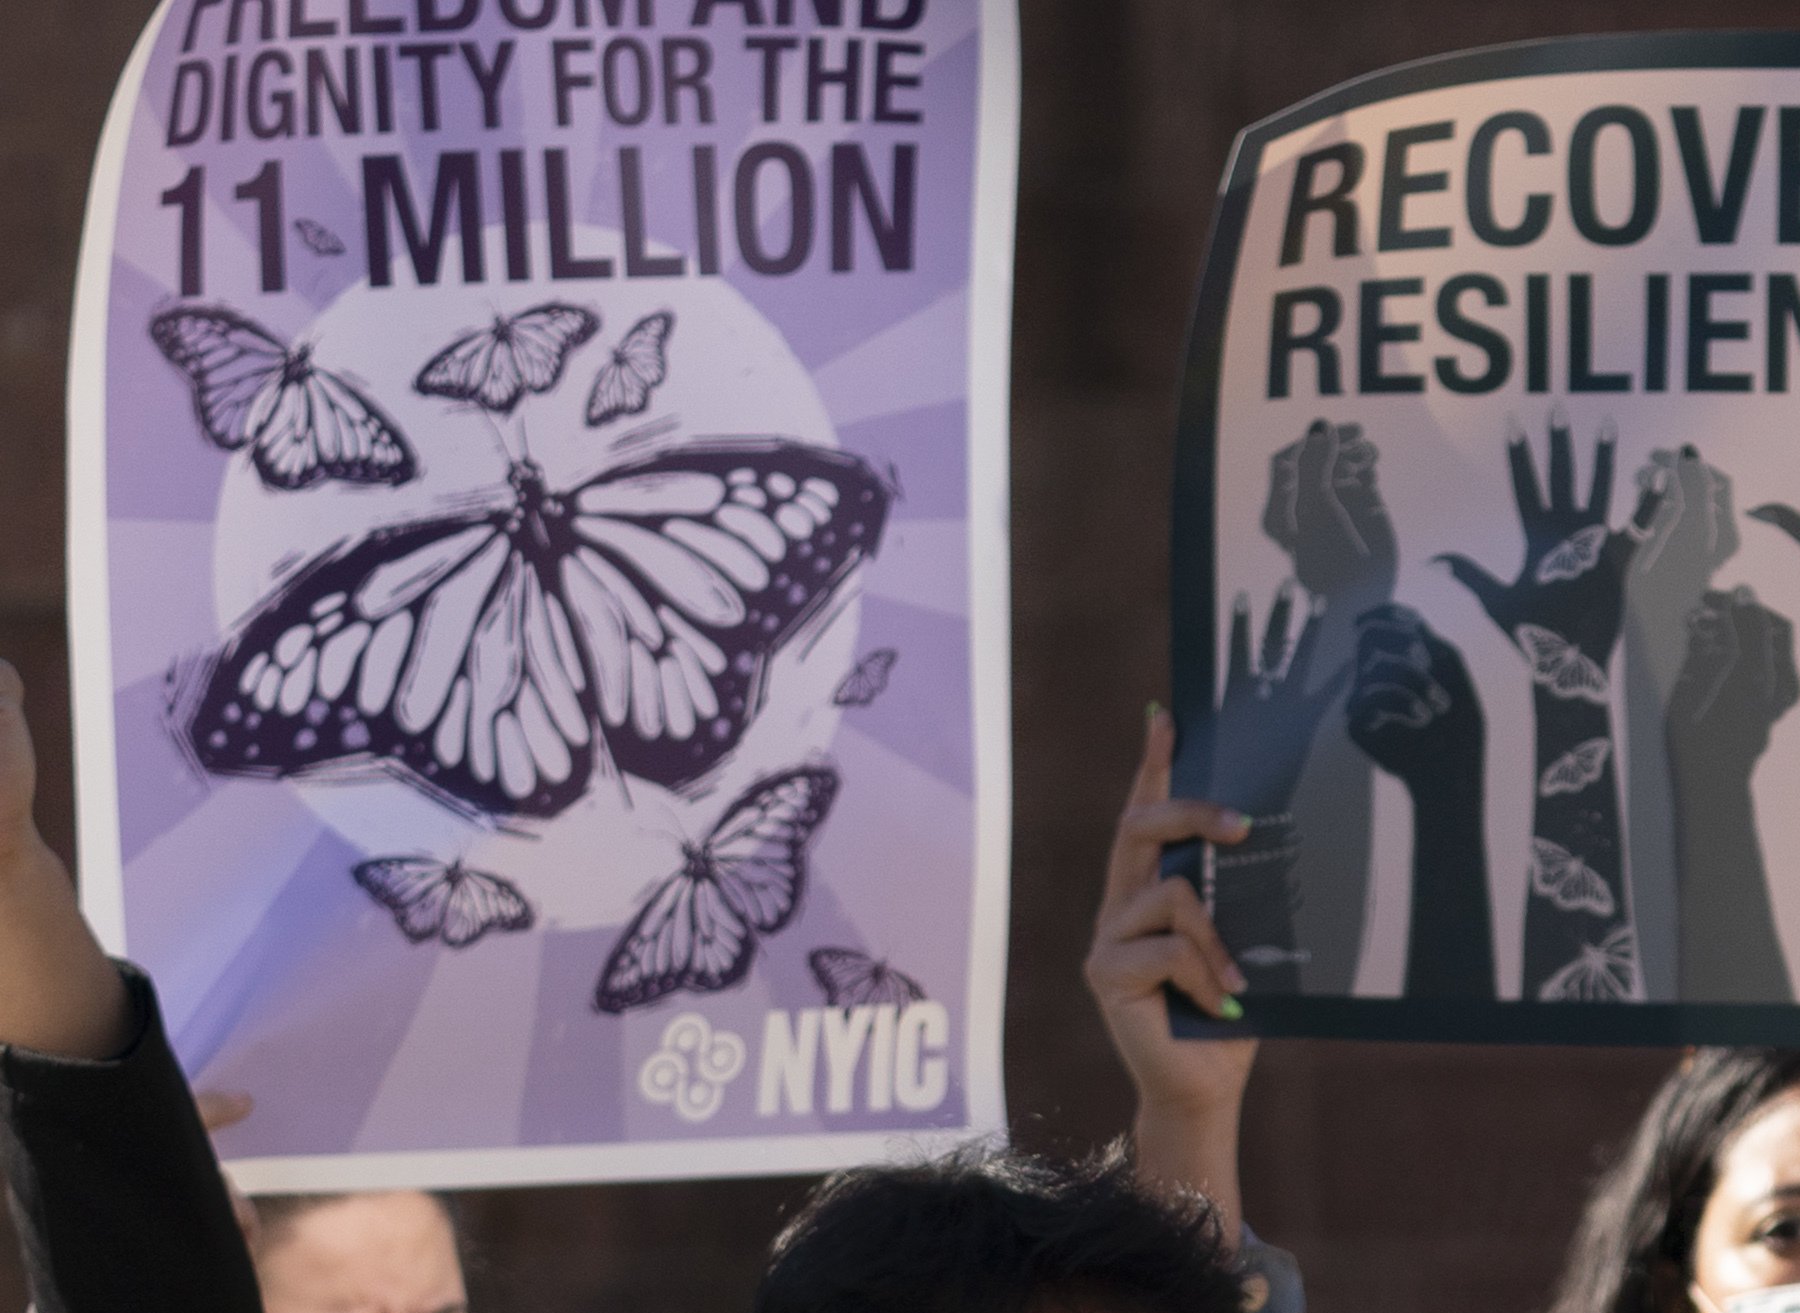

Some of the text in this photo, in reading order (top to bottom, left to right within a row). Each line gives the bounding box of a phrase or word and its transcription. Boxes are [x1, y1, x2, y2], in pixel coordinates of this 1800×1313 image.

[166, 37, 924, 146] DIGNITY FOR THE
[161, 142, 918, 298] 11 MILLION
[755, 999, 948, 1116] NYIC
